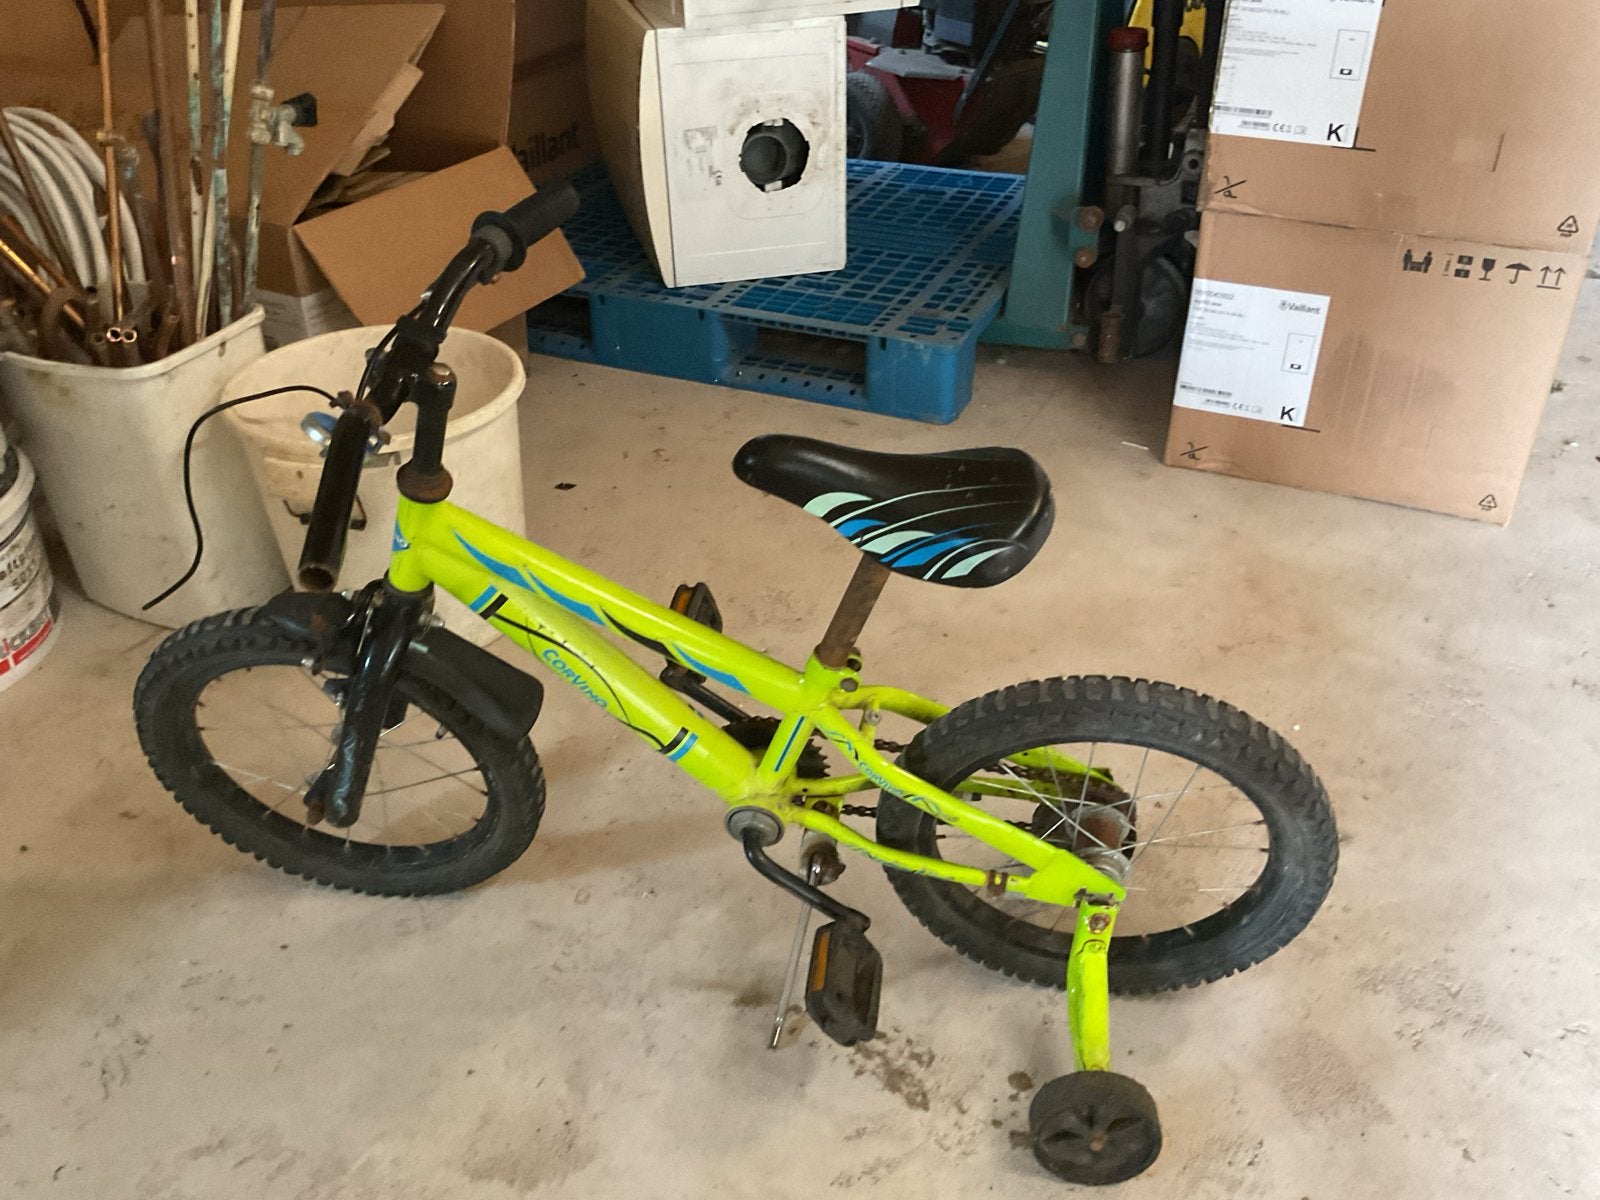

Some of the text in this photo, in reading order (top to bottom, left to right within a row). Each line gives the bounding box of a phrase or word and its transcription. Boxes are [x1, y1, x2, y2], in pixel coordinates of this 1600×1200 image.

[1326, 123, 1344, 142] K
[512, 121, 583, 173] aillant
[1287, 302, 1321, 315] Vaillant
[1280, 405, 1295, 421] K
